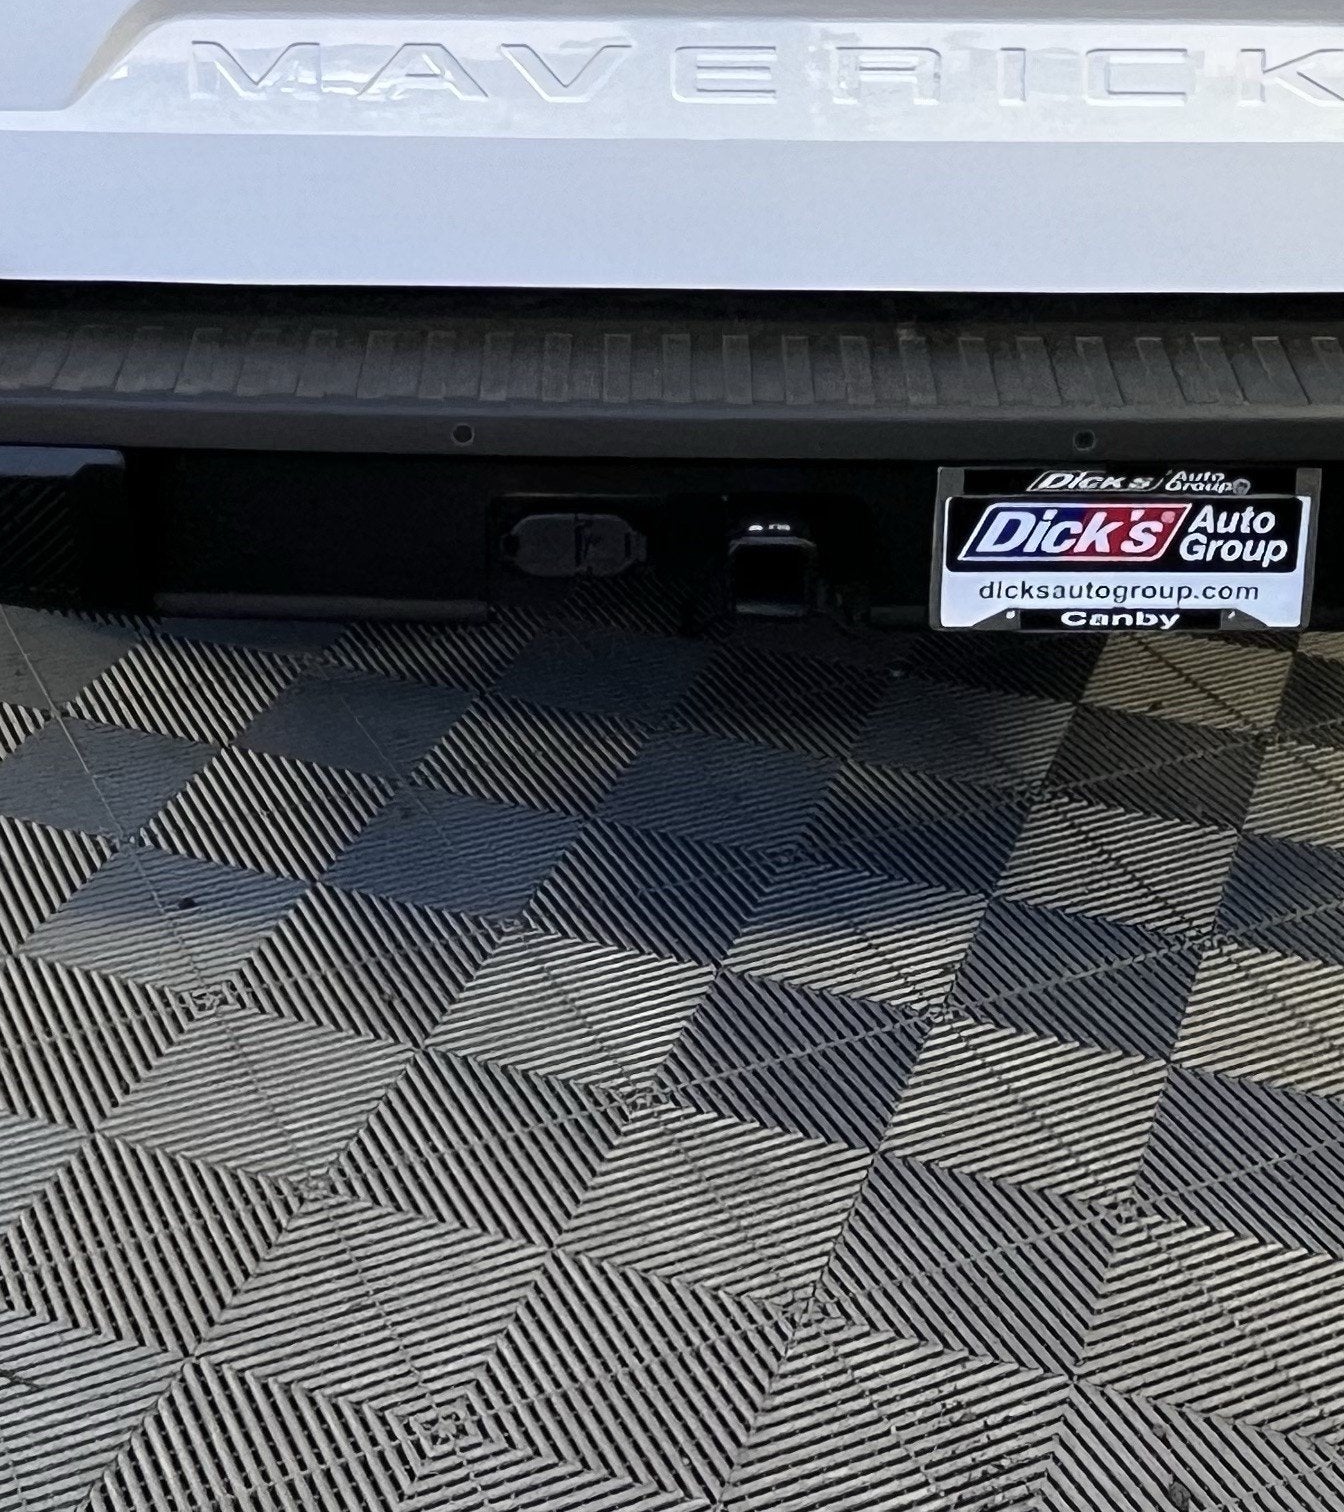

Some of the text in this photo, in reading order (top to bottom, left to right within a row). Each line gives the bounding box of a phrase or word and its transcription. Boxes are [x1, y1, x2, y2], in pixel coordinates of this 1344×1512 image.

[975, 508, 1164, 554] Dick's
[1187, 505, 1276, 534] Auto
[1179, 533, 1288, 567] Group
[978, 580, 1259, 605] dicksautogroup.com
[1060, 611, 1180, 630] Canby
